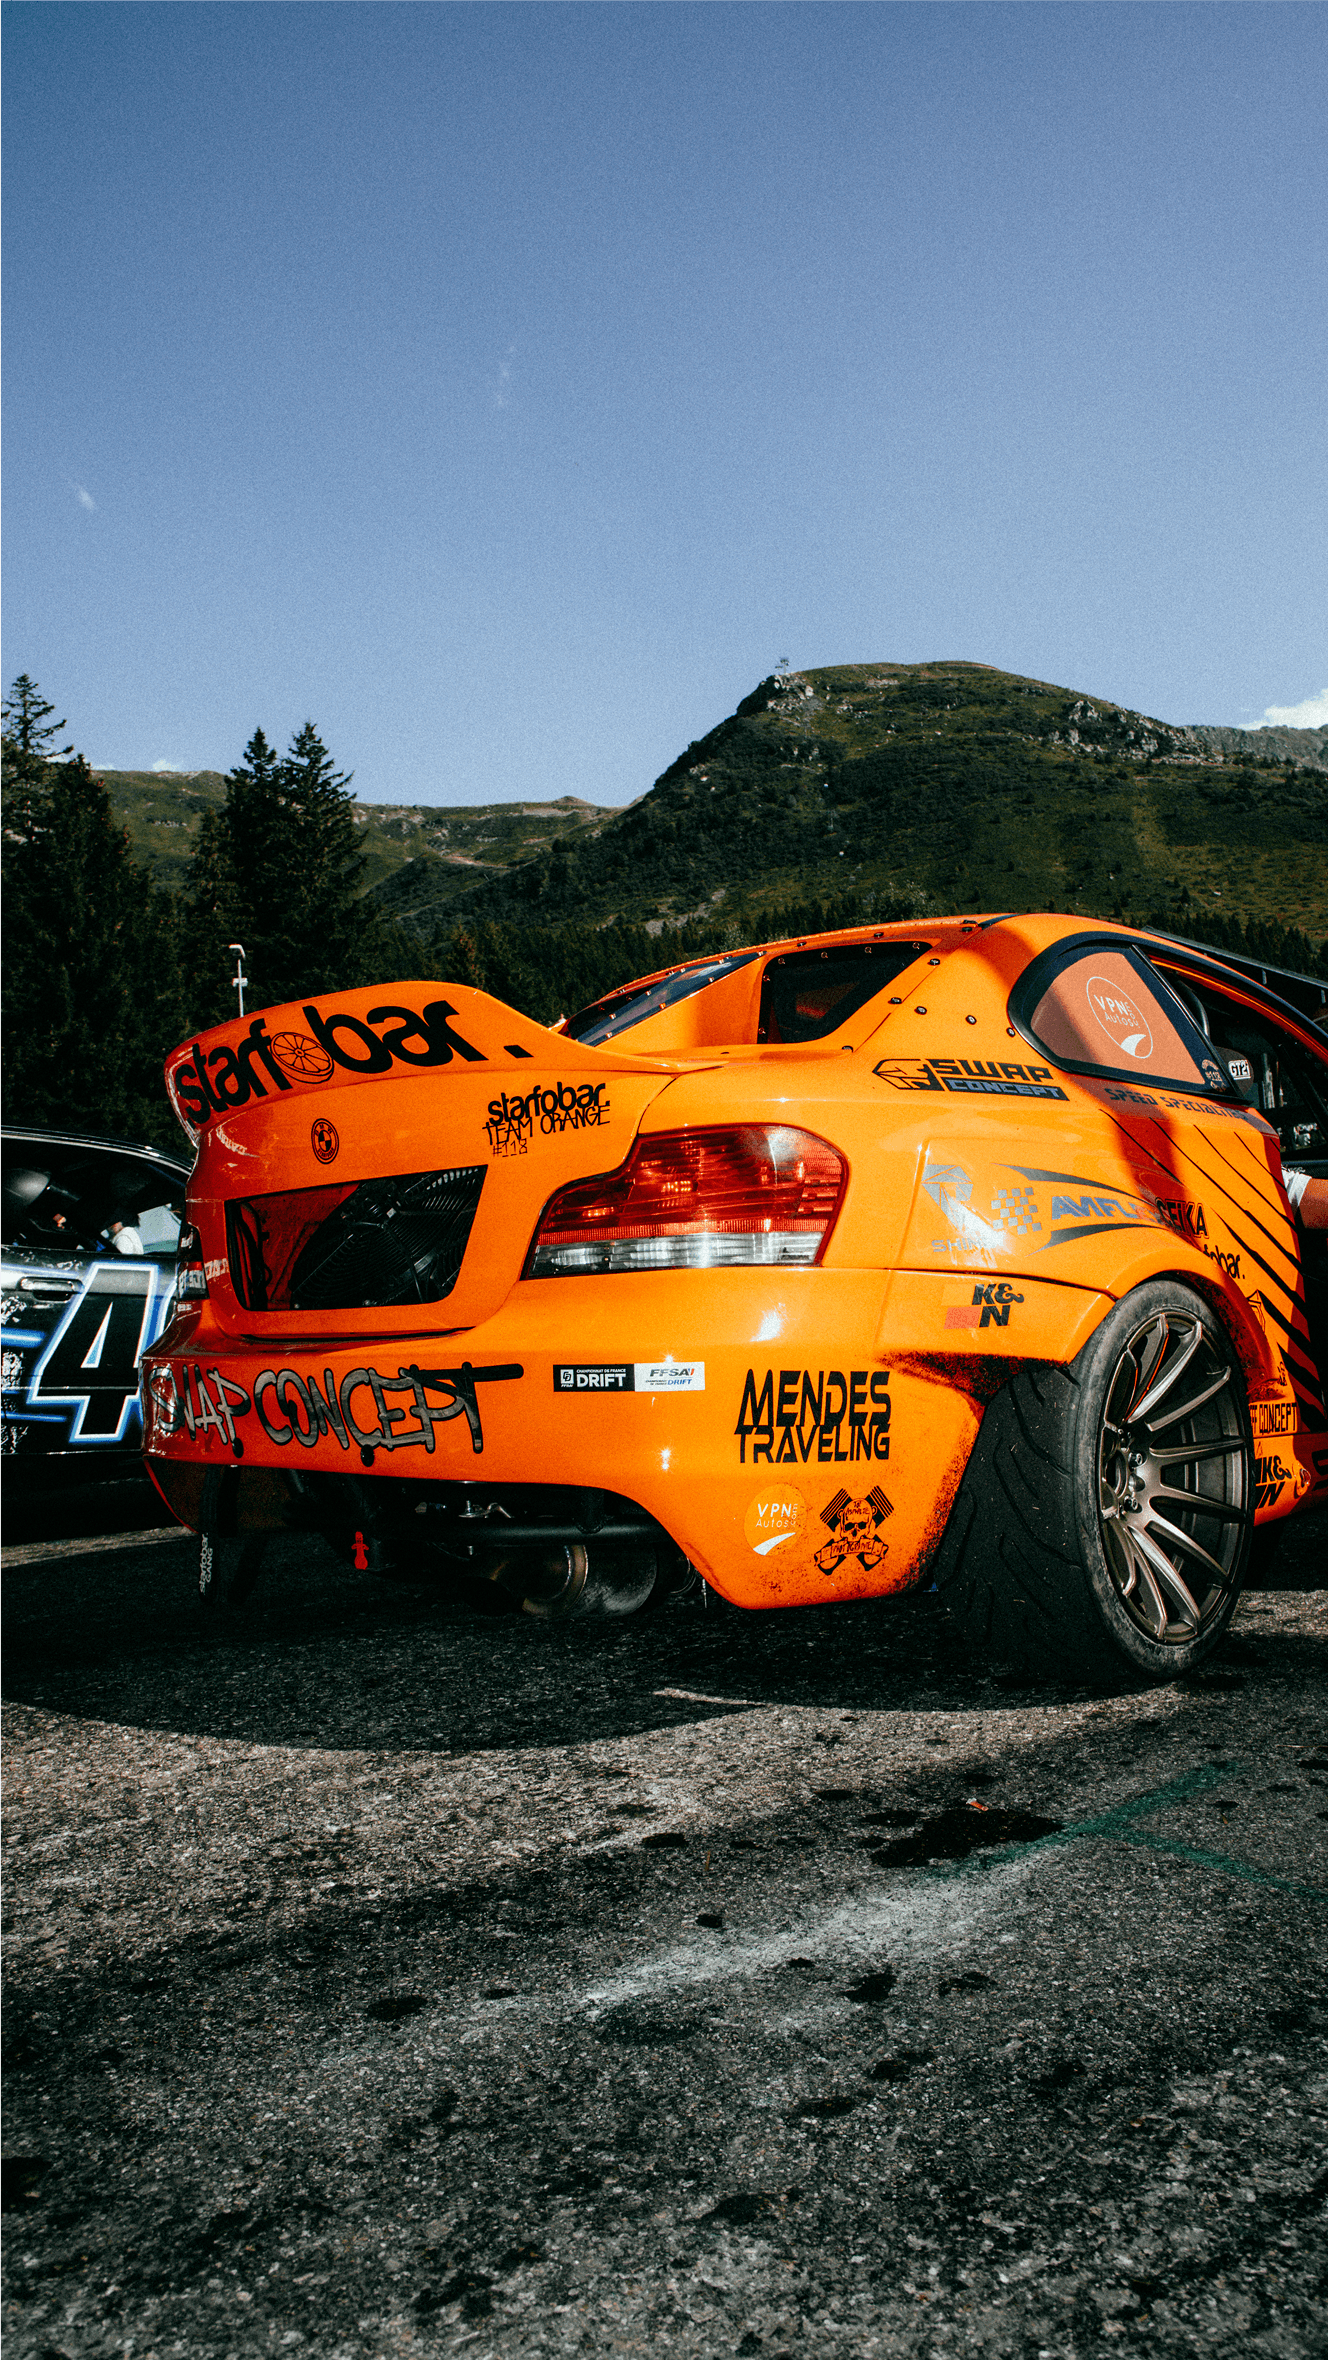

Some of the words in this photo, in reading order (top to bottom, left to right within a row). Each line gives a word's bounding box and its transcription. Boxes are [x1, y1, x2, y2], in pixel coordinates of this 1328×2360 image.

[1093, 994, 1129, 1016] VPN
[1105, 1012, 1134, 1027] Autos
[925, 1059, 1054, 1082] SWAP
[950, 1079, 1060, 1098] CONCEPT
[1104, 1088, 1158, 1105] SPEED
[488, 1081, 610, 1126] starfobar.
[482, 1116, 533, 1146] TEAM
[540, 1105, 610, 1134] ORANGE
[492, 1138, 528, 1157] #118
[972, 1283, 1025, 1306] K&
[979, 1305, 1011, 1328] N
[576, 1373, 626, 1387] DRIFT
[253, 1362, 524, 1456] CONCEPT
[735, 1369, 891, 1427] MENDES
[1259, 1402, 1297, 1434] CONCEPT
[734, 1424, 891, 1463] TRAVELING
[757, 1503, 792, 1518] VPN
[755, 1518, 789, 1528] Autos
